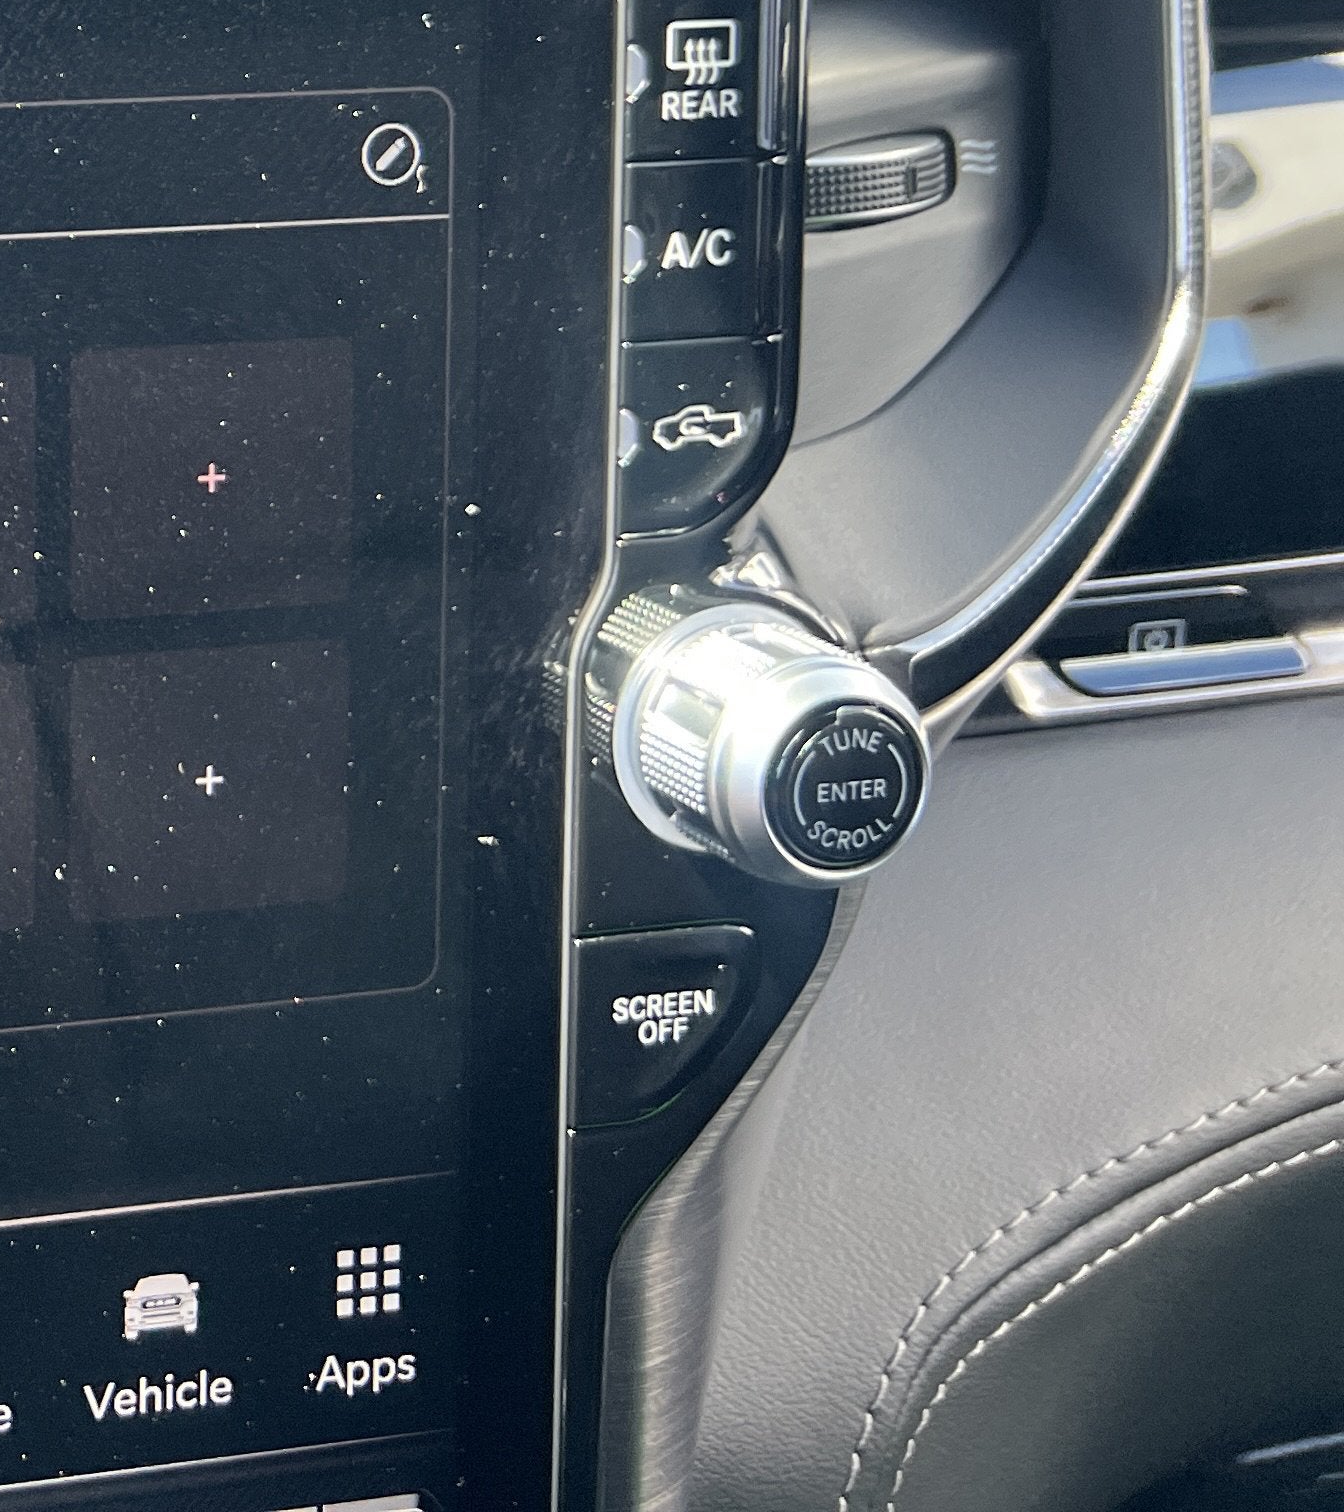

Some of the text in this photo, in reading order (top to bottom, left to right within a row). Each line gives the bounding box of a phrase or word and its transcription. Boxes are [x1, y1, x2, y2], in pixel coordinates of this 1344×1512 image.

[661, 91, 739, 121] REAR
[661, 227, 736, 270] A/C
[818, 729, 884, 757] TUNE
[816, 778, 887, 804] ENTER
[807, 817, 892, 850] SCROLL
[612, 989, 715, 1022] SCREEN
[638, 1018, 688, 1044] OFF
[317, 1353, 417, 1395] Apps
[84, 1370, 234, 1421] Vehicle
